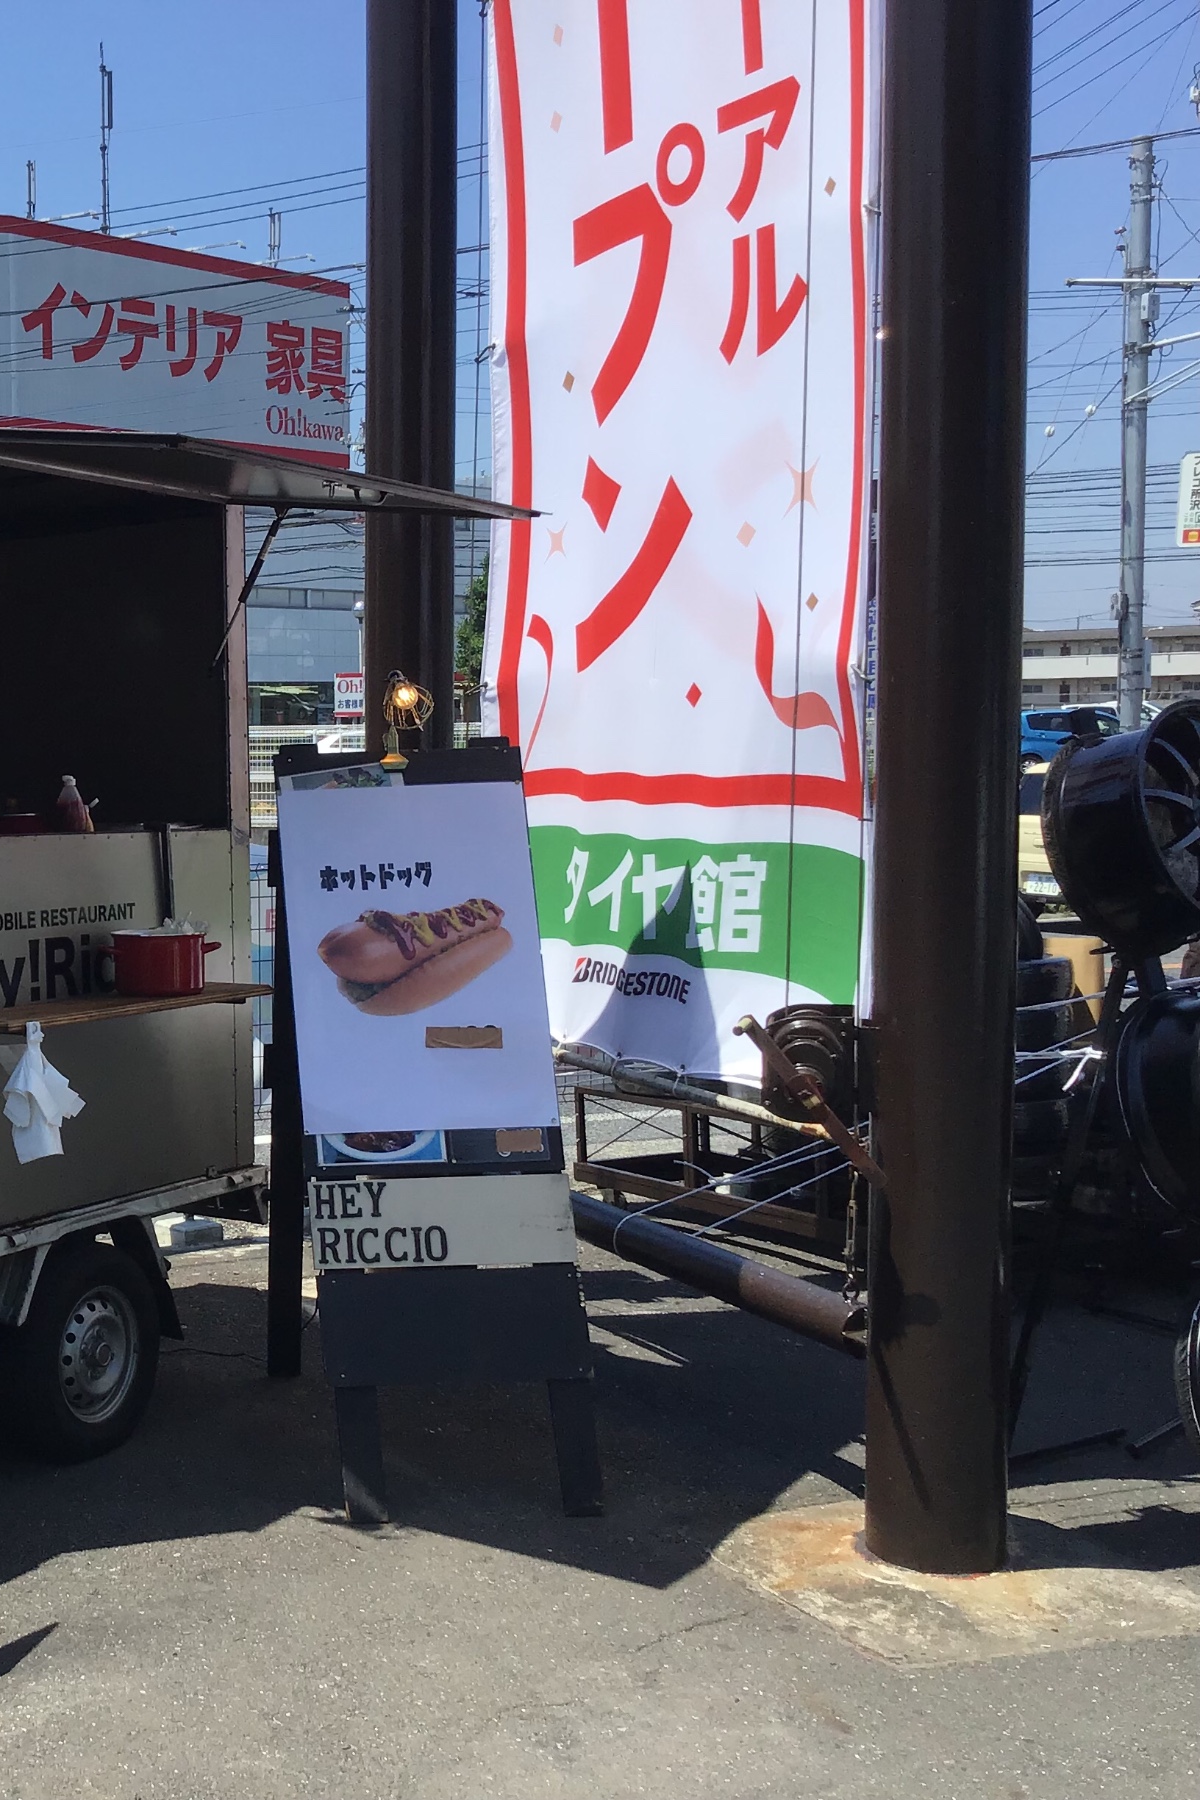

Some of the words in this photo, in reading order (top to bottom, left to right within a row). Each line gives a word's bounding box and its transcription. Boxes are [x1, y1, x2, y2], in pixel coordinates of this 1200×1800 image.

[21, 282, 243, 382] インテリア
[266, 320, 346, 404] 家具
[265, 405, 344, 442] Oh!kawa
[40, 902, 135, 928] RESTAURANT
[564, 846, 767, 953] タイヤ館
[572, 957, 690, 1004] BRIDGESTONE
[313, 1182, 386, 1219] HEY
[316, 1225, 448, 1264] RICCIO
